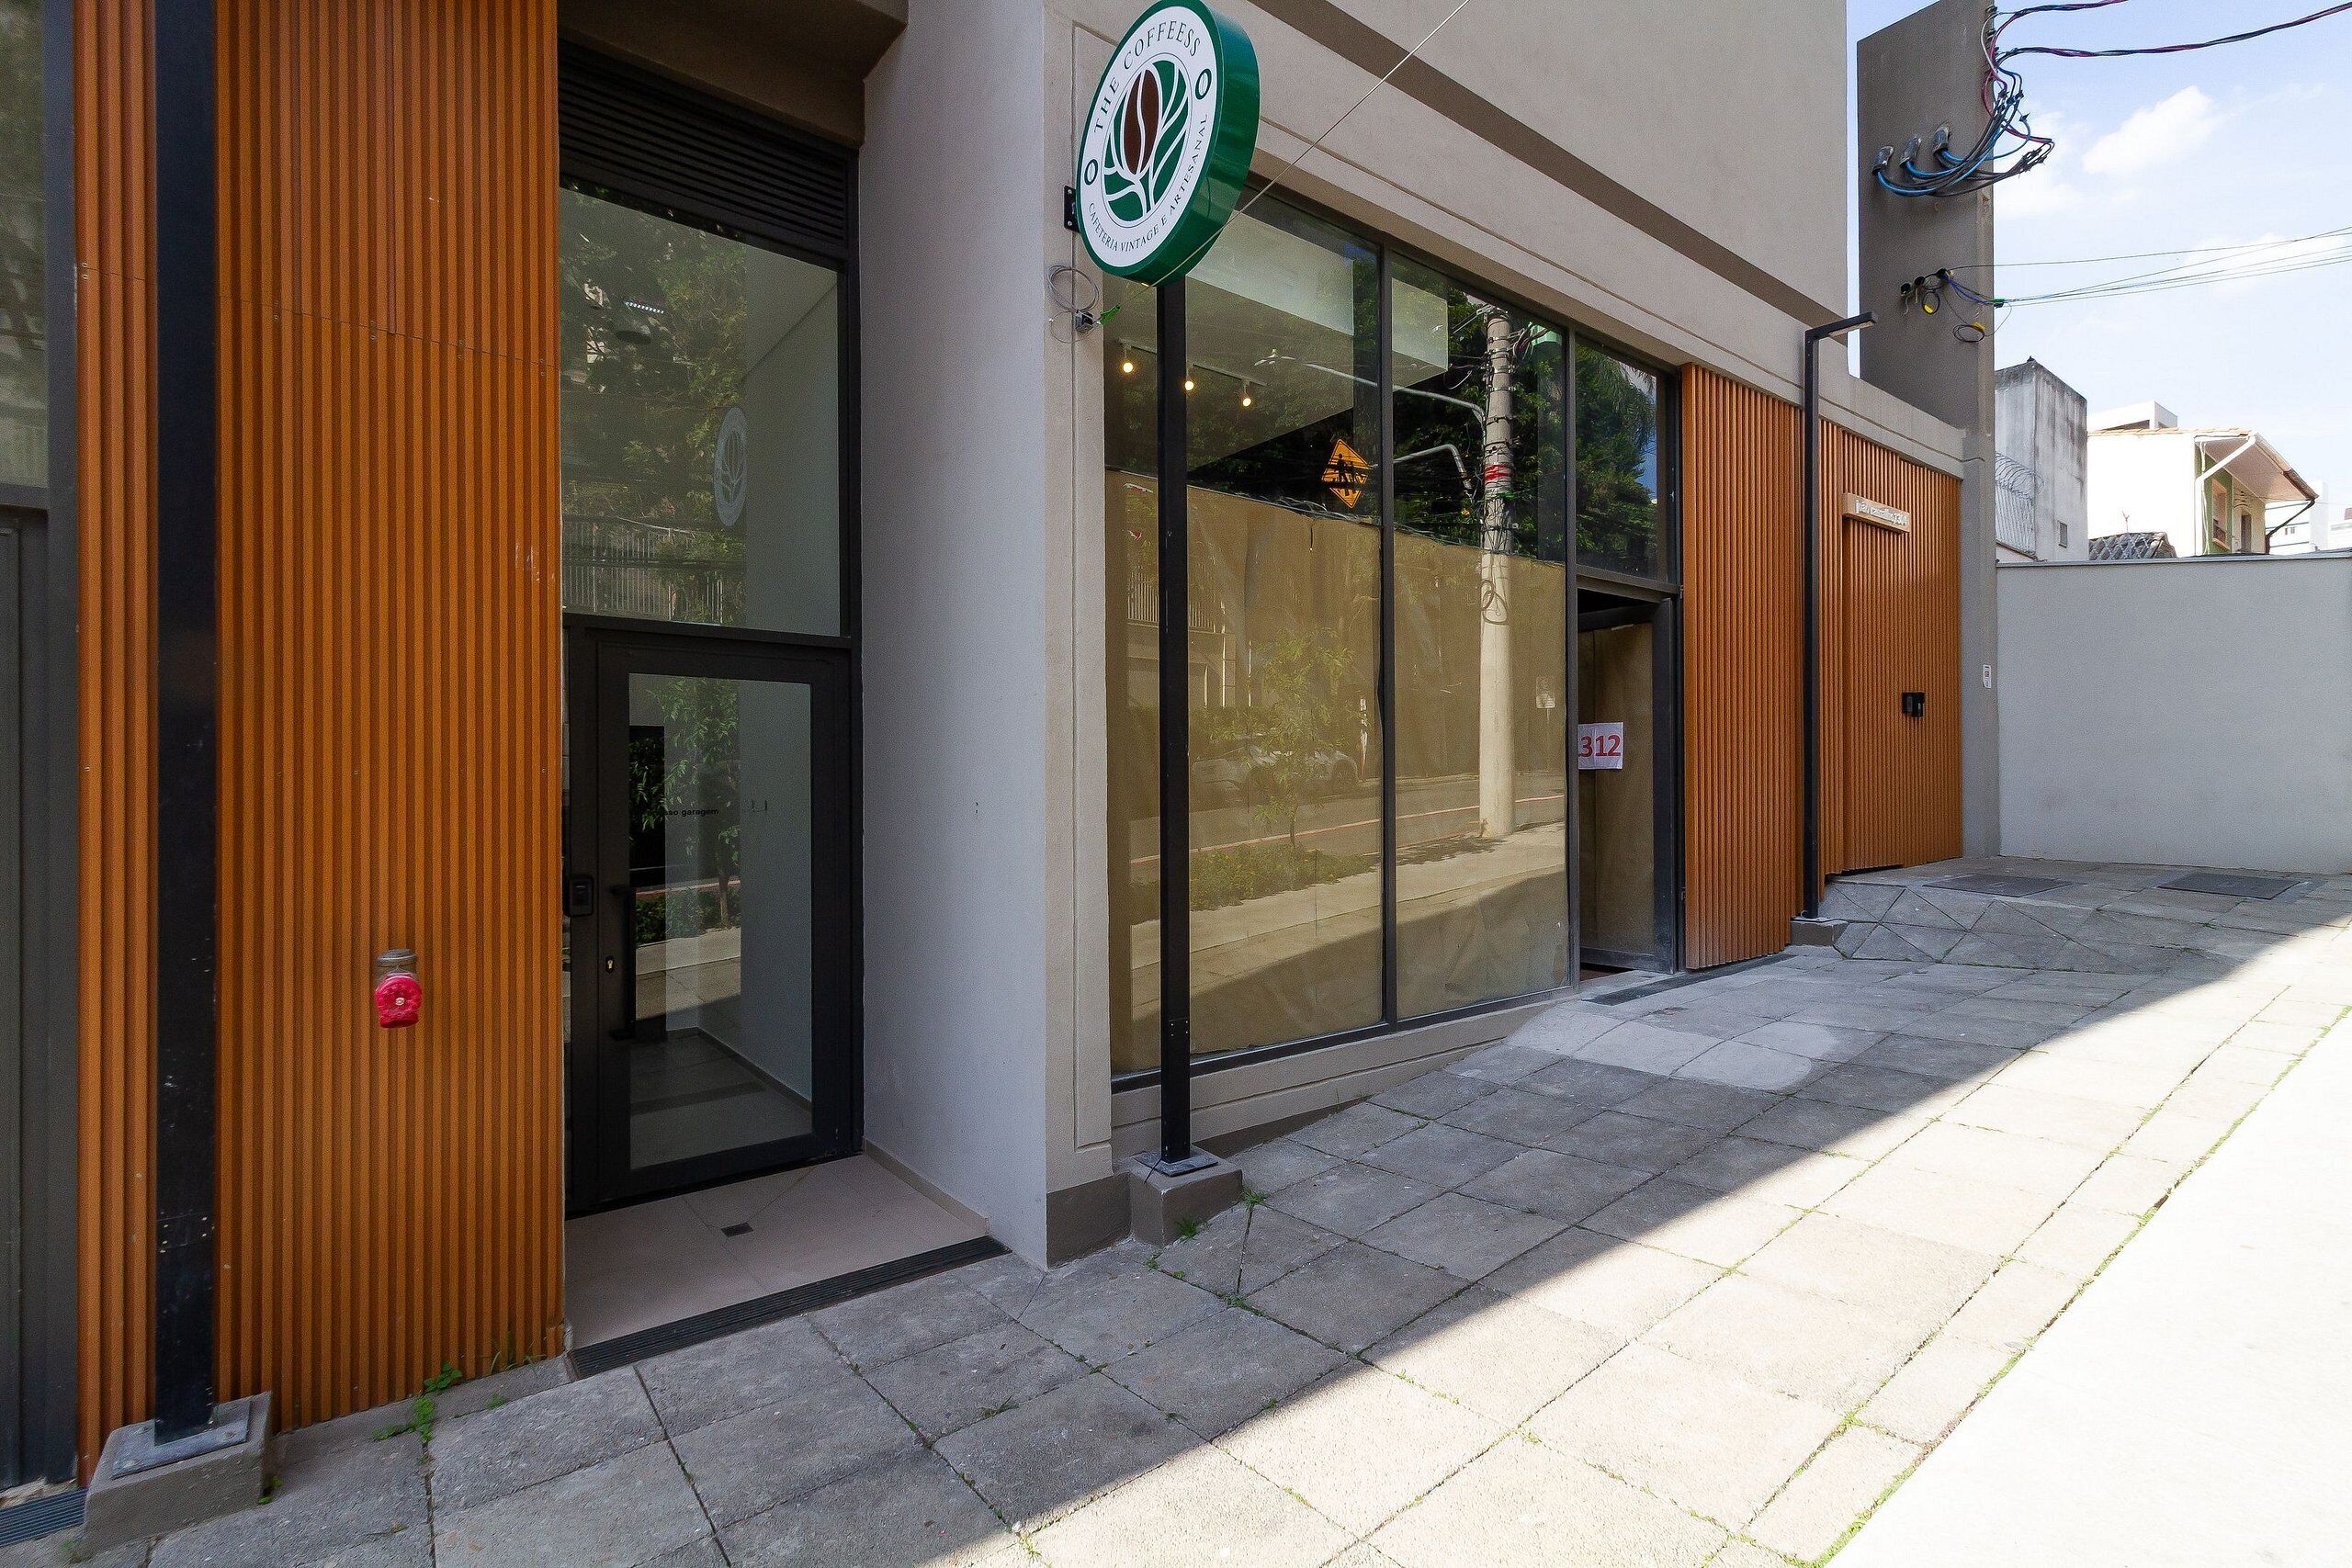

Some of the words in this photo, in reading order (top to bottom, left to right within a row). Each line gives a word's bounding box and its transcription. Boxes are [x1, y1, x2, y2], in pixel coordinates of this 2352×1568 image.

[1094, 77, 1120, 132] THE
[1124, 20, 1201, 69] COFFEESS
[1089, 203, 1117, 252] CAFETERIA
[1121, 224, 1159, 252] VINTAGE
[1160, 214, 1168, 226] E
[1170, 114, 1208, 215] ARTESANAL
[1577, 734, 1622, 758] 312
